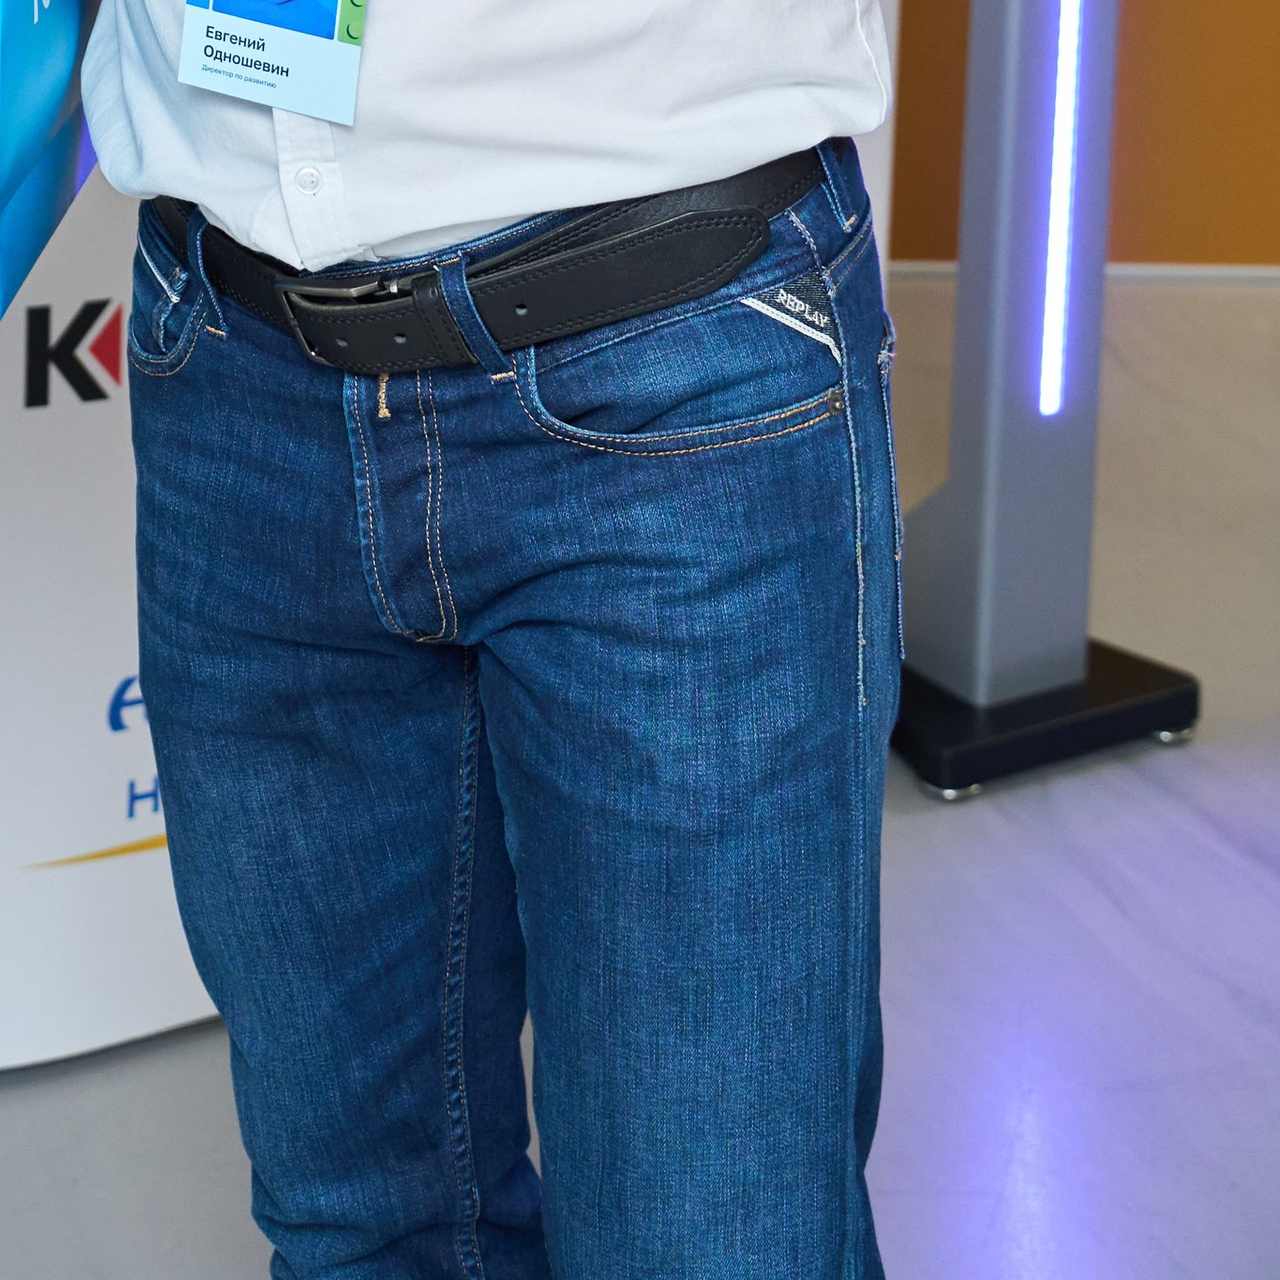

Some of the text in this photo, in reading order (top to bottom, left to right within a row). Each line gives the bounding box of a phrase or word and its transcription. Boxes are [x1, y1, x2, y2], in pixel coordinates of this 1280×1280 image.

[205, 25, 266, 52] Евгений
[203, 44, 290, 77] Одношевин
[201, 64, 234, 78] Директор
[244, 75, 277, 89] развитию
[776, 288, 830, 327] REPLAY
